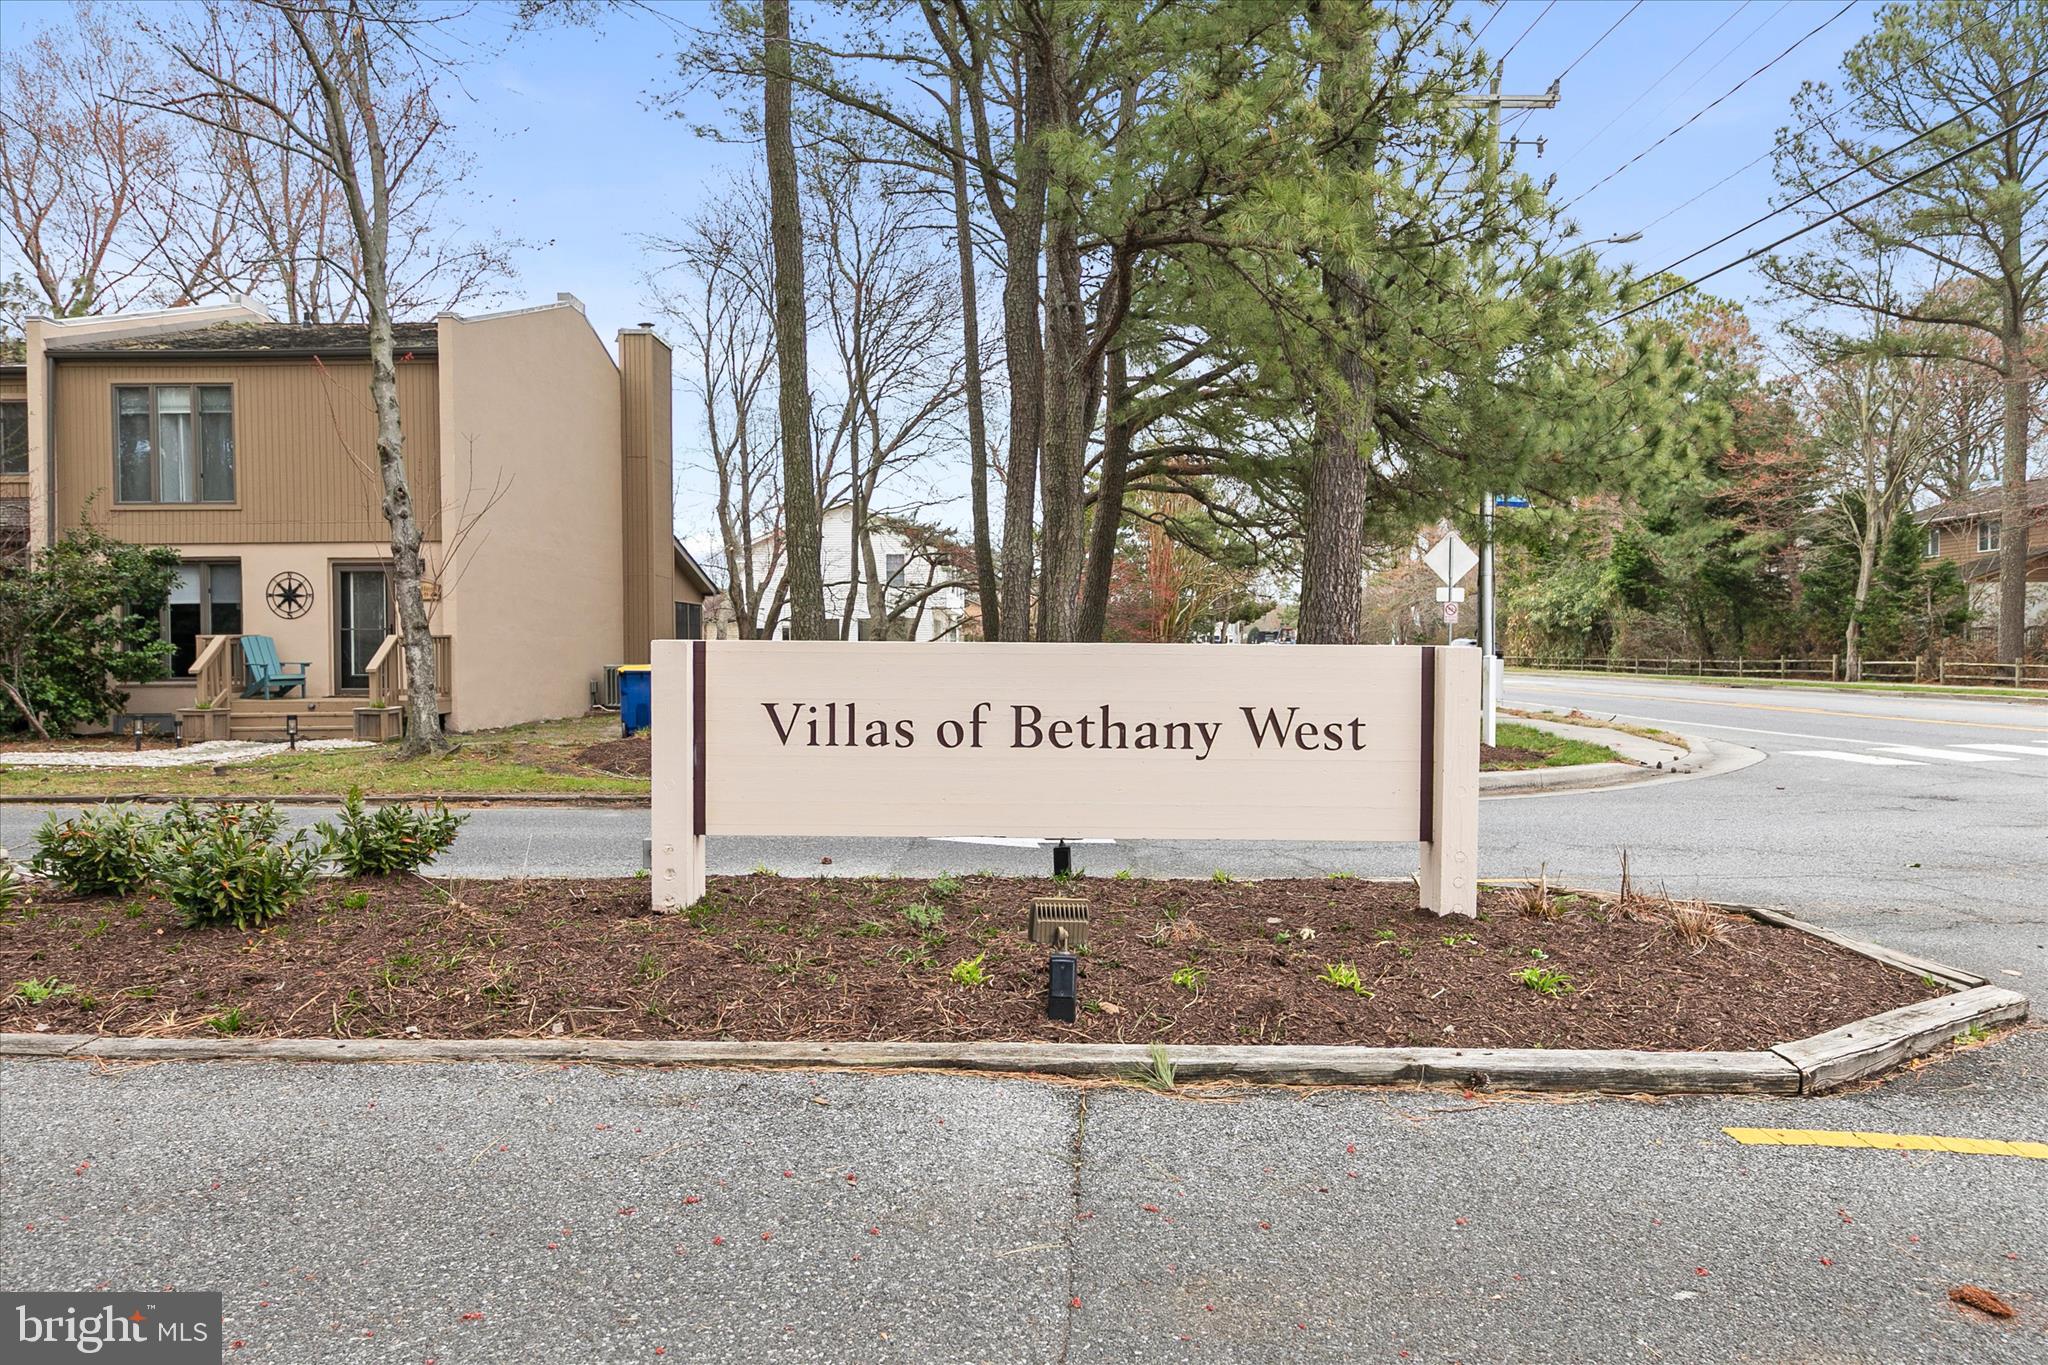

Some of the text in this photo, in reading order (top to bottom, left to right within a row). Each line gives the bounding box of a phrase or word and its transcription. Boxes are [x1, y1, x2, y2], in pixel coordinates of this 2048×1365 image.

[760, 702, 1367, 761] Villas of Bethany West
